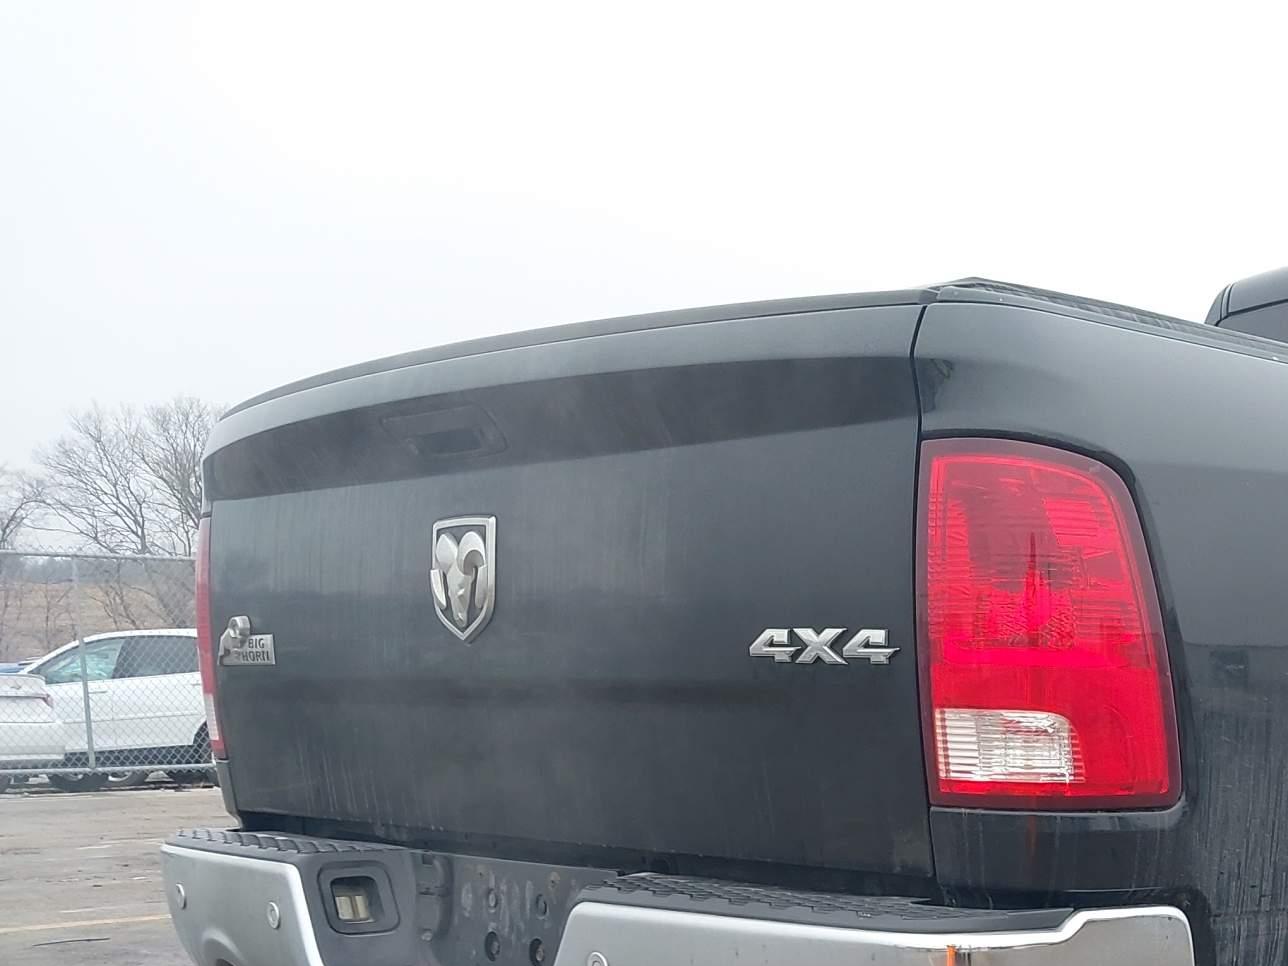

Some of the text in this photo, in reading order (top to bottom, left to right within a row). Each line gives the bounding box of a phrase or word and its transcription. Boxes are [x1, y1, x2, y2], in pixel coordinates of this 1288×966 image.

[248, 638, 265, 649] BIG
[749, 627, 900, 665] 4X4
[241, 650, 271, 662] HORN
